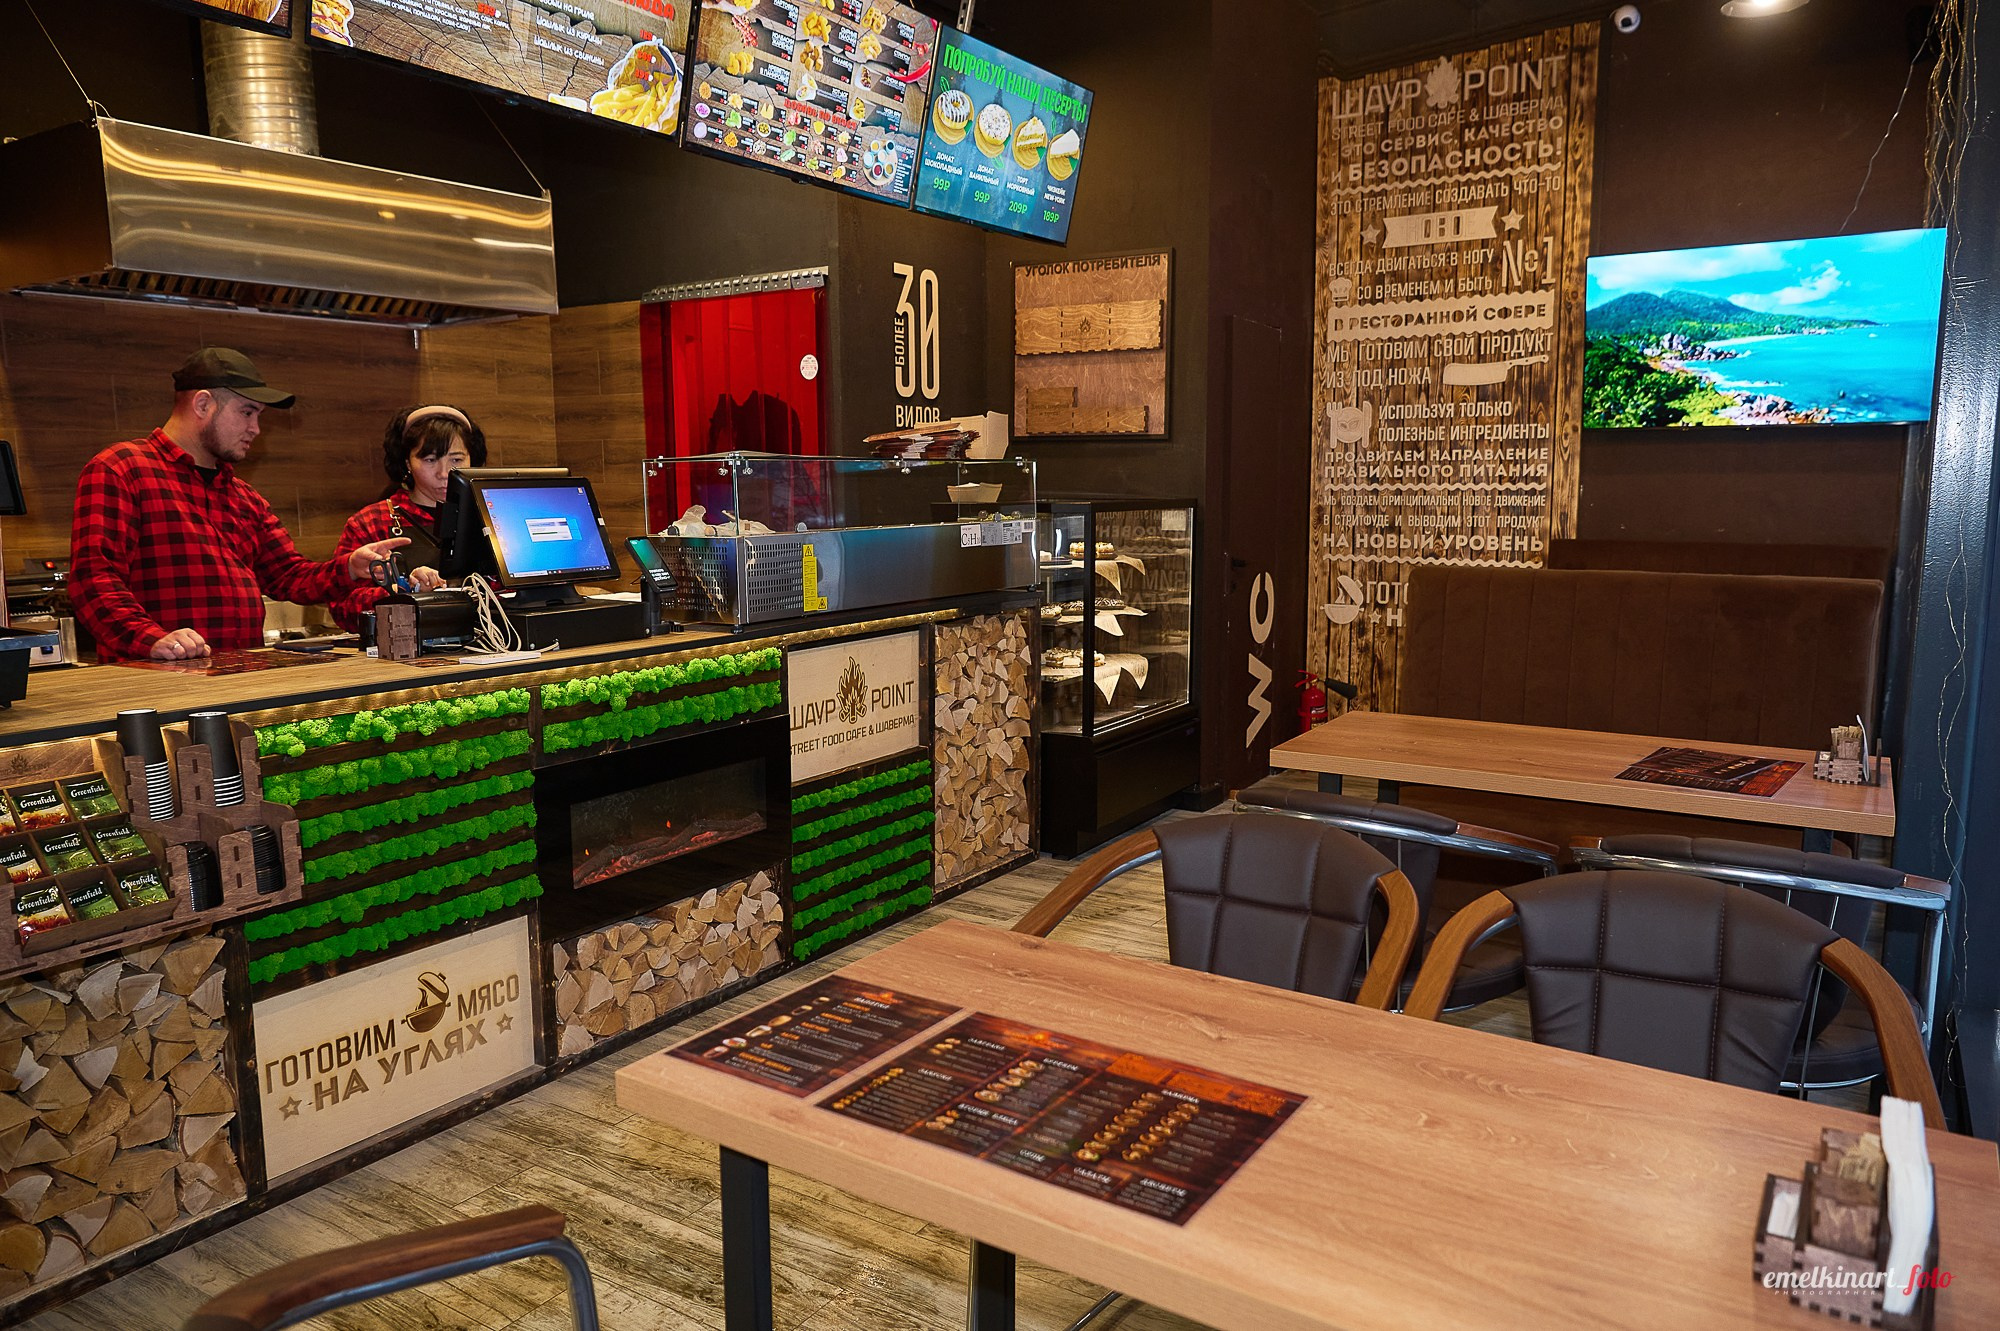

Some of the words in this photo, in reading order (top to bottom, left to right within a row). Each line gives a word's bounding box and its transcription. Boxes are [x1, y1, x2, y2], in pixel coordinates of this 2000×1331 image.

[944, 44, 1005, 90] ПОПРОБУЙ
[1006, 71, 1040, 104] НАШИ
[1041, 87, 1088, 123] ДЕСЕРТЫ
[1331, 78, 1422, 120] ШАУР
[1463, 55, 1567, 101] POINT
[1331, 120, 1384, 141] STREET
[1387, 115, 1425, 133] FOOD
[1427, 109, 1465, 128] CAFE
[1469, 109, 1479, 122] &
[1483, 95, 1564, 121] ШАВЕРМА
[1380, 130, 1459, 153] СЕРВИС,
[1463, 116, 1564, 142] КАЧЕСТВО
[925, 158, 963, 176] ШОКОЛАДНЫЙ
[936, 151, 955, 163] ДОНАТ
[1349, 137, 1563, 182] БЕЗОПАСНОСТЬ!
[1330, 200, 1352, 217] ЭТО
[1353, 190, 1432, 213] СТРЕМЛЕНИЕ
[1435, 182, 1509, 204] СОЗДАВАТЬ
[1512, 175, 1562, 196] ЧТО-ТО
[1025, 262, 1070, 278] УГОЛОК
[1072, 254, 1161, 274] ПОТРЕБИТЕЛЯ
[1329, 257, 1372, 277] ВСЕГДА
[1375, 251, 1446, 274] ДВИГАТЬСЯ
[1450, 251, 1457, 266] В
[1463, 248, 1495, 266] НОГУ
[1357, 286, 1371, 300] СО
[1375, 280, 1441, 299] ВРЕМЕНЕМ
[1444, 279, 1454, 293] И
[1458, 276, 1493, 293] БЫТЬ
[1334, 318, 1344, 331] В
[1349, 305, 1478, 331] РЕСТОРАННОЙ
[1483, 303, 1547, 320] СФЕРЕ
[893, 262, 940, 399] 30
[894, 317, 905, 366] БОЛЕЕ
[1358, 340, 1429, 362] ГОТОВИМ
[1433, 335, 1475, 358] СВОЙ
[1480, 332, 1554, 356] ПРОДУКТ
[1326, 370, 1345, 389] ИЗ
[1354, 369, 1384, 390] ПОД
[1388, 365, 1432, 387] НОЖА
[1378, 403, 1455, 420] ИСПОЛЬЗУЯ
[1459, 400, 1513, 418] ТОЛЬКО
[1378, 424, 1446, 442] ПОЛЕЗНЫЕ
[1449, 423, 1550, 442] ИНГРЕДИЕНТЫ
[1324, 450, 1425, 463] ПРОДВИГАЕМ
[1430, 447, 1549, 461] НАПРАВЛЕНИЕ
[1324, 464, 1454, 478] ПРАВИЛЬНОГО
[1459, 463, 1548, 478] ПИТАНИЯ
[1382, 495, 1460, 507] ПРИНЦИПИАЛЬНО
[1462, 495, 1492, 506] НОВОЕ
[1494, 495, 1546, 508] ДВИЖЕНИЕ
[1408, 515, 1460, 529] ВЫВОДИМ
[1466, 515, 1490, 528] ЭТОТ
[1497, 515, 1545, 530] ПРОДУКТ
[1323, 532, 1350, 548] НА
[1355, 530, 1434, 550] НОВЫЙ
[1440, 534, 1544, 552] УРОВЕНЬ
[1246, 571, 1275, 749] WC
[871, 680, 915, 713] POINT
[822, 732, 845, 749] FOOD
[845, 726, 867, 742] CAFE
[868, 724, 875, 735] &
[875, 713, 915, 734] ШАВЕРМА
[20, 795, 57, 809] Greenfield
[70, 784, 105, 798] Greenfield
[96, 826, 130, 839] Greenfield
[44, 837, 80, 853] Greenfield
[17, 894, 55, 912] Greenfield
[69, 887, 102, 905] reenfield
[265, 1018, 397, 1095] ГОТОВИМ
[457, 974, 520, 1023] МЯСО
[314, 1068, 369, 1112] НА
[377, 1018, 488, 1085] УГЛЯХ
